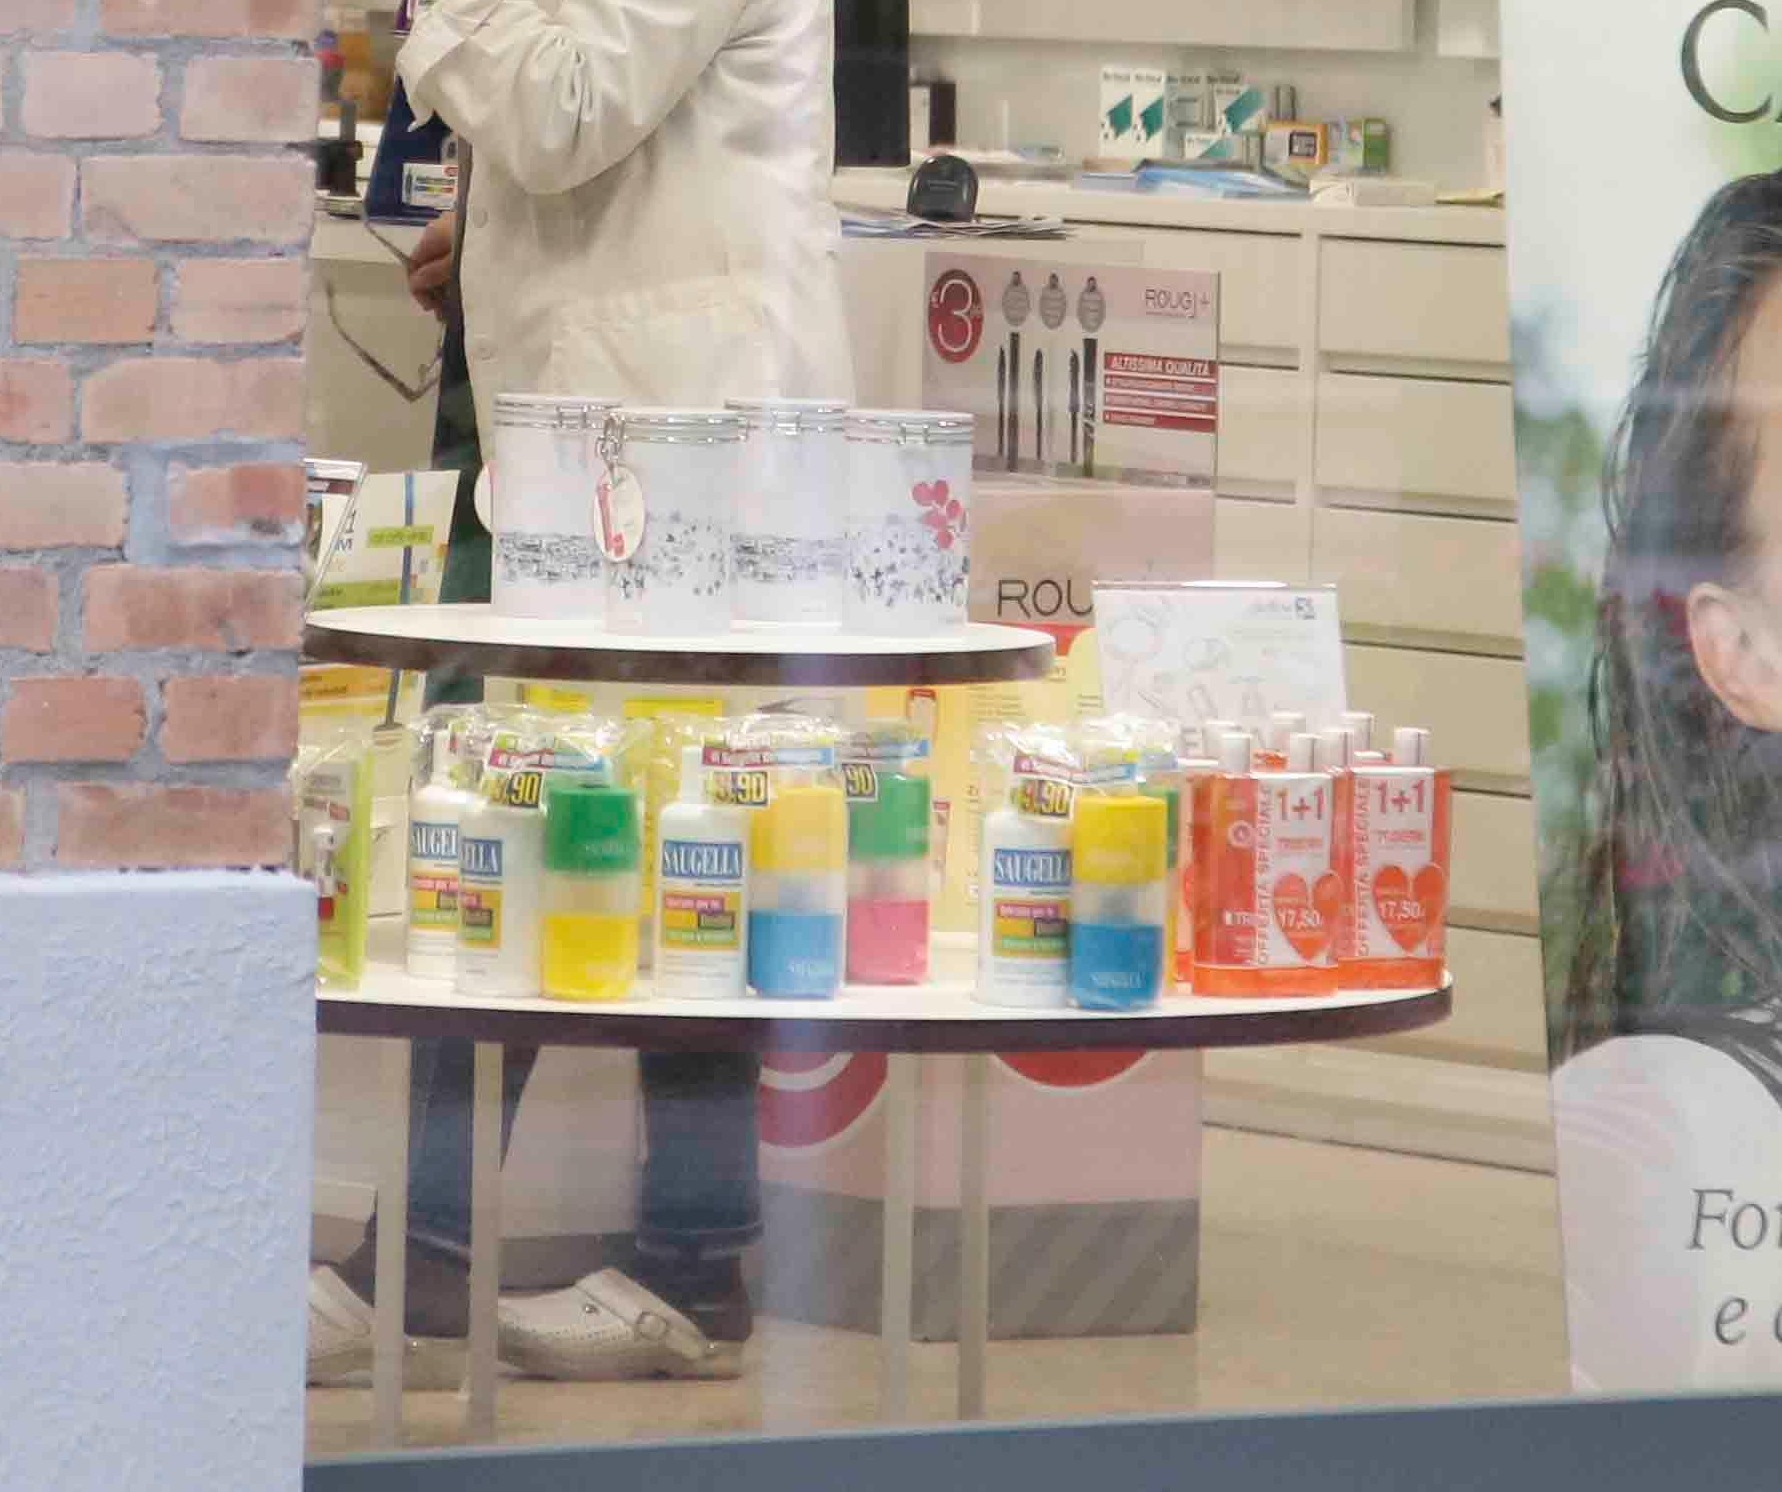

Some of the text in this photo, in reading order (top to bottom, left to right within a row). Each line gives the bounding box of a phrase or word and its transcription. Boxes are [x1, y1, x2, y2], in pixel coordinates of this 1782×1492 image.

[1275, 787, 1325, 822] 1+1
[1375, 780, 1425, 815] 1+1
[663, 844, 741, 877] SAUGELLA
[994, 853, 1069, 885] SAUGELL
[1714, 1294, 1749, 1347] e
